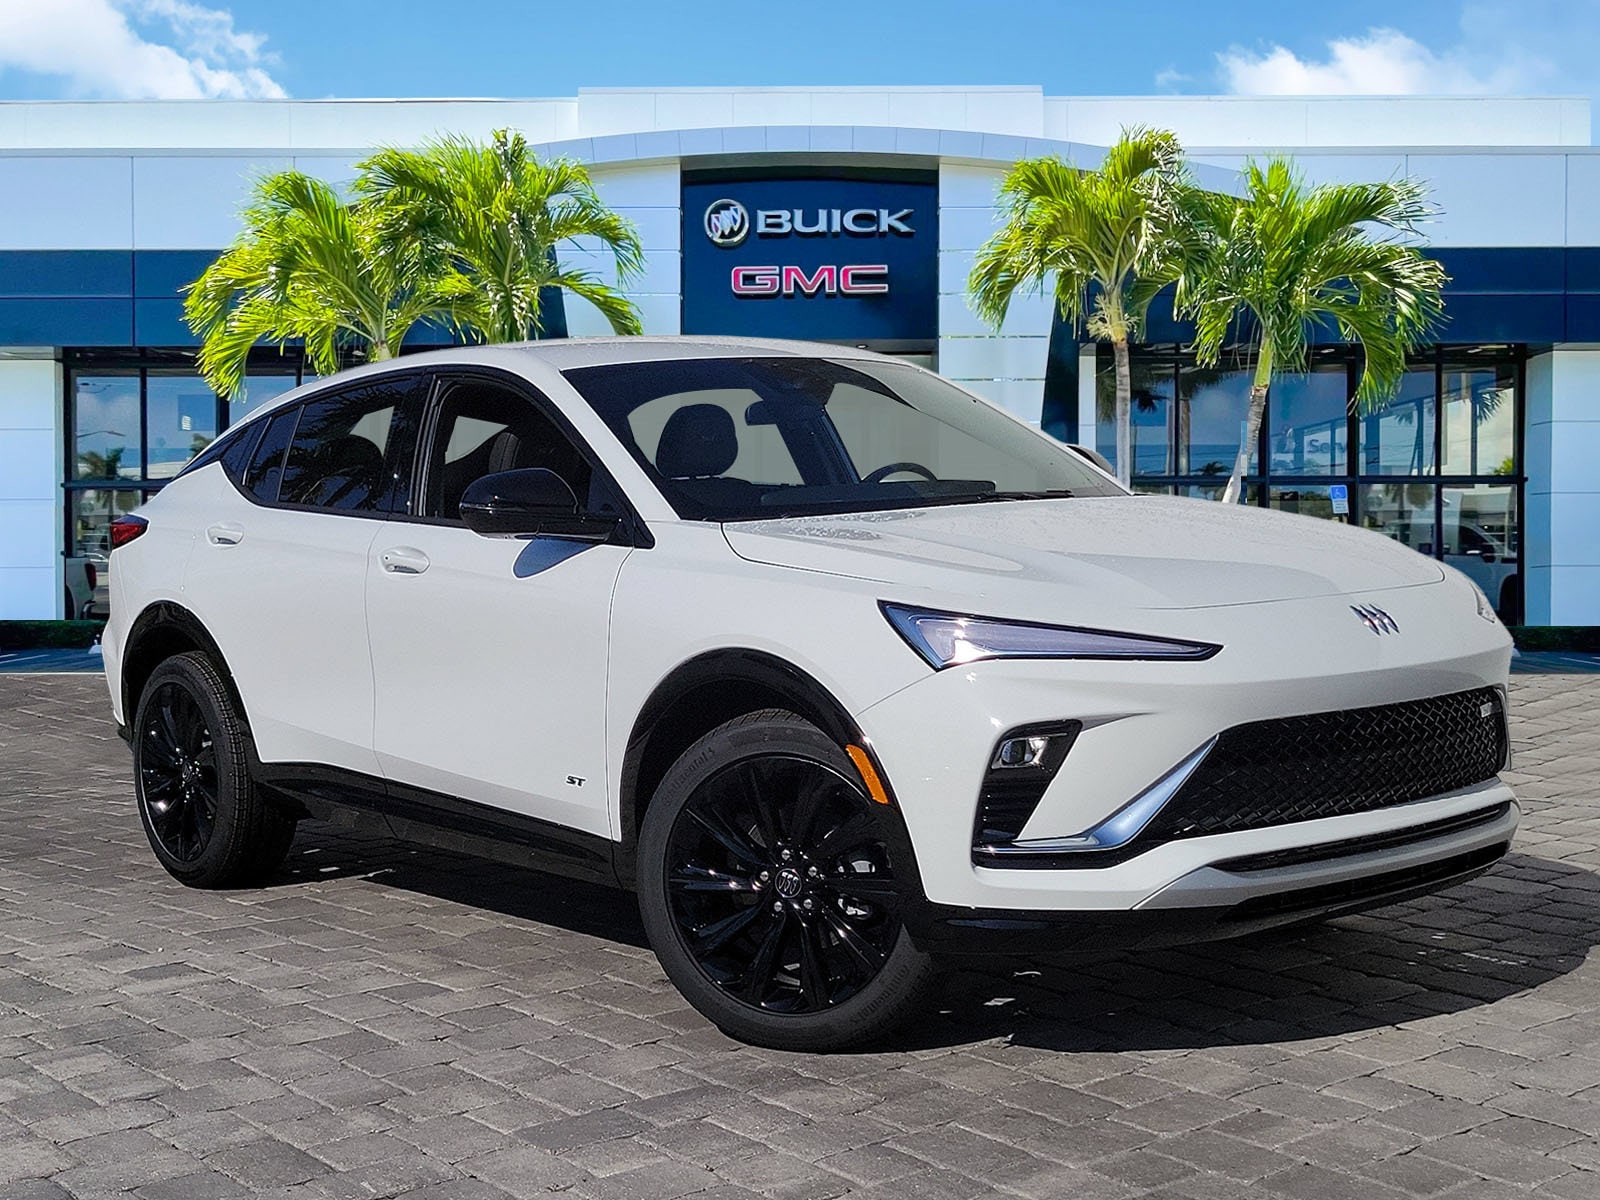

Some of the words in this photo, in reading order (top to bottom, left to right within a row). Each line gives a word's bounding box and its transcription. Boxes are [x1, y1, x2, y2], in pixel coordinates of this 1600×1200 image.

[757, 208, 915, 234] BUICK
[731, 264, 889, 294] GMC
[565, 775, 586, 787] ST
